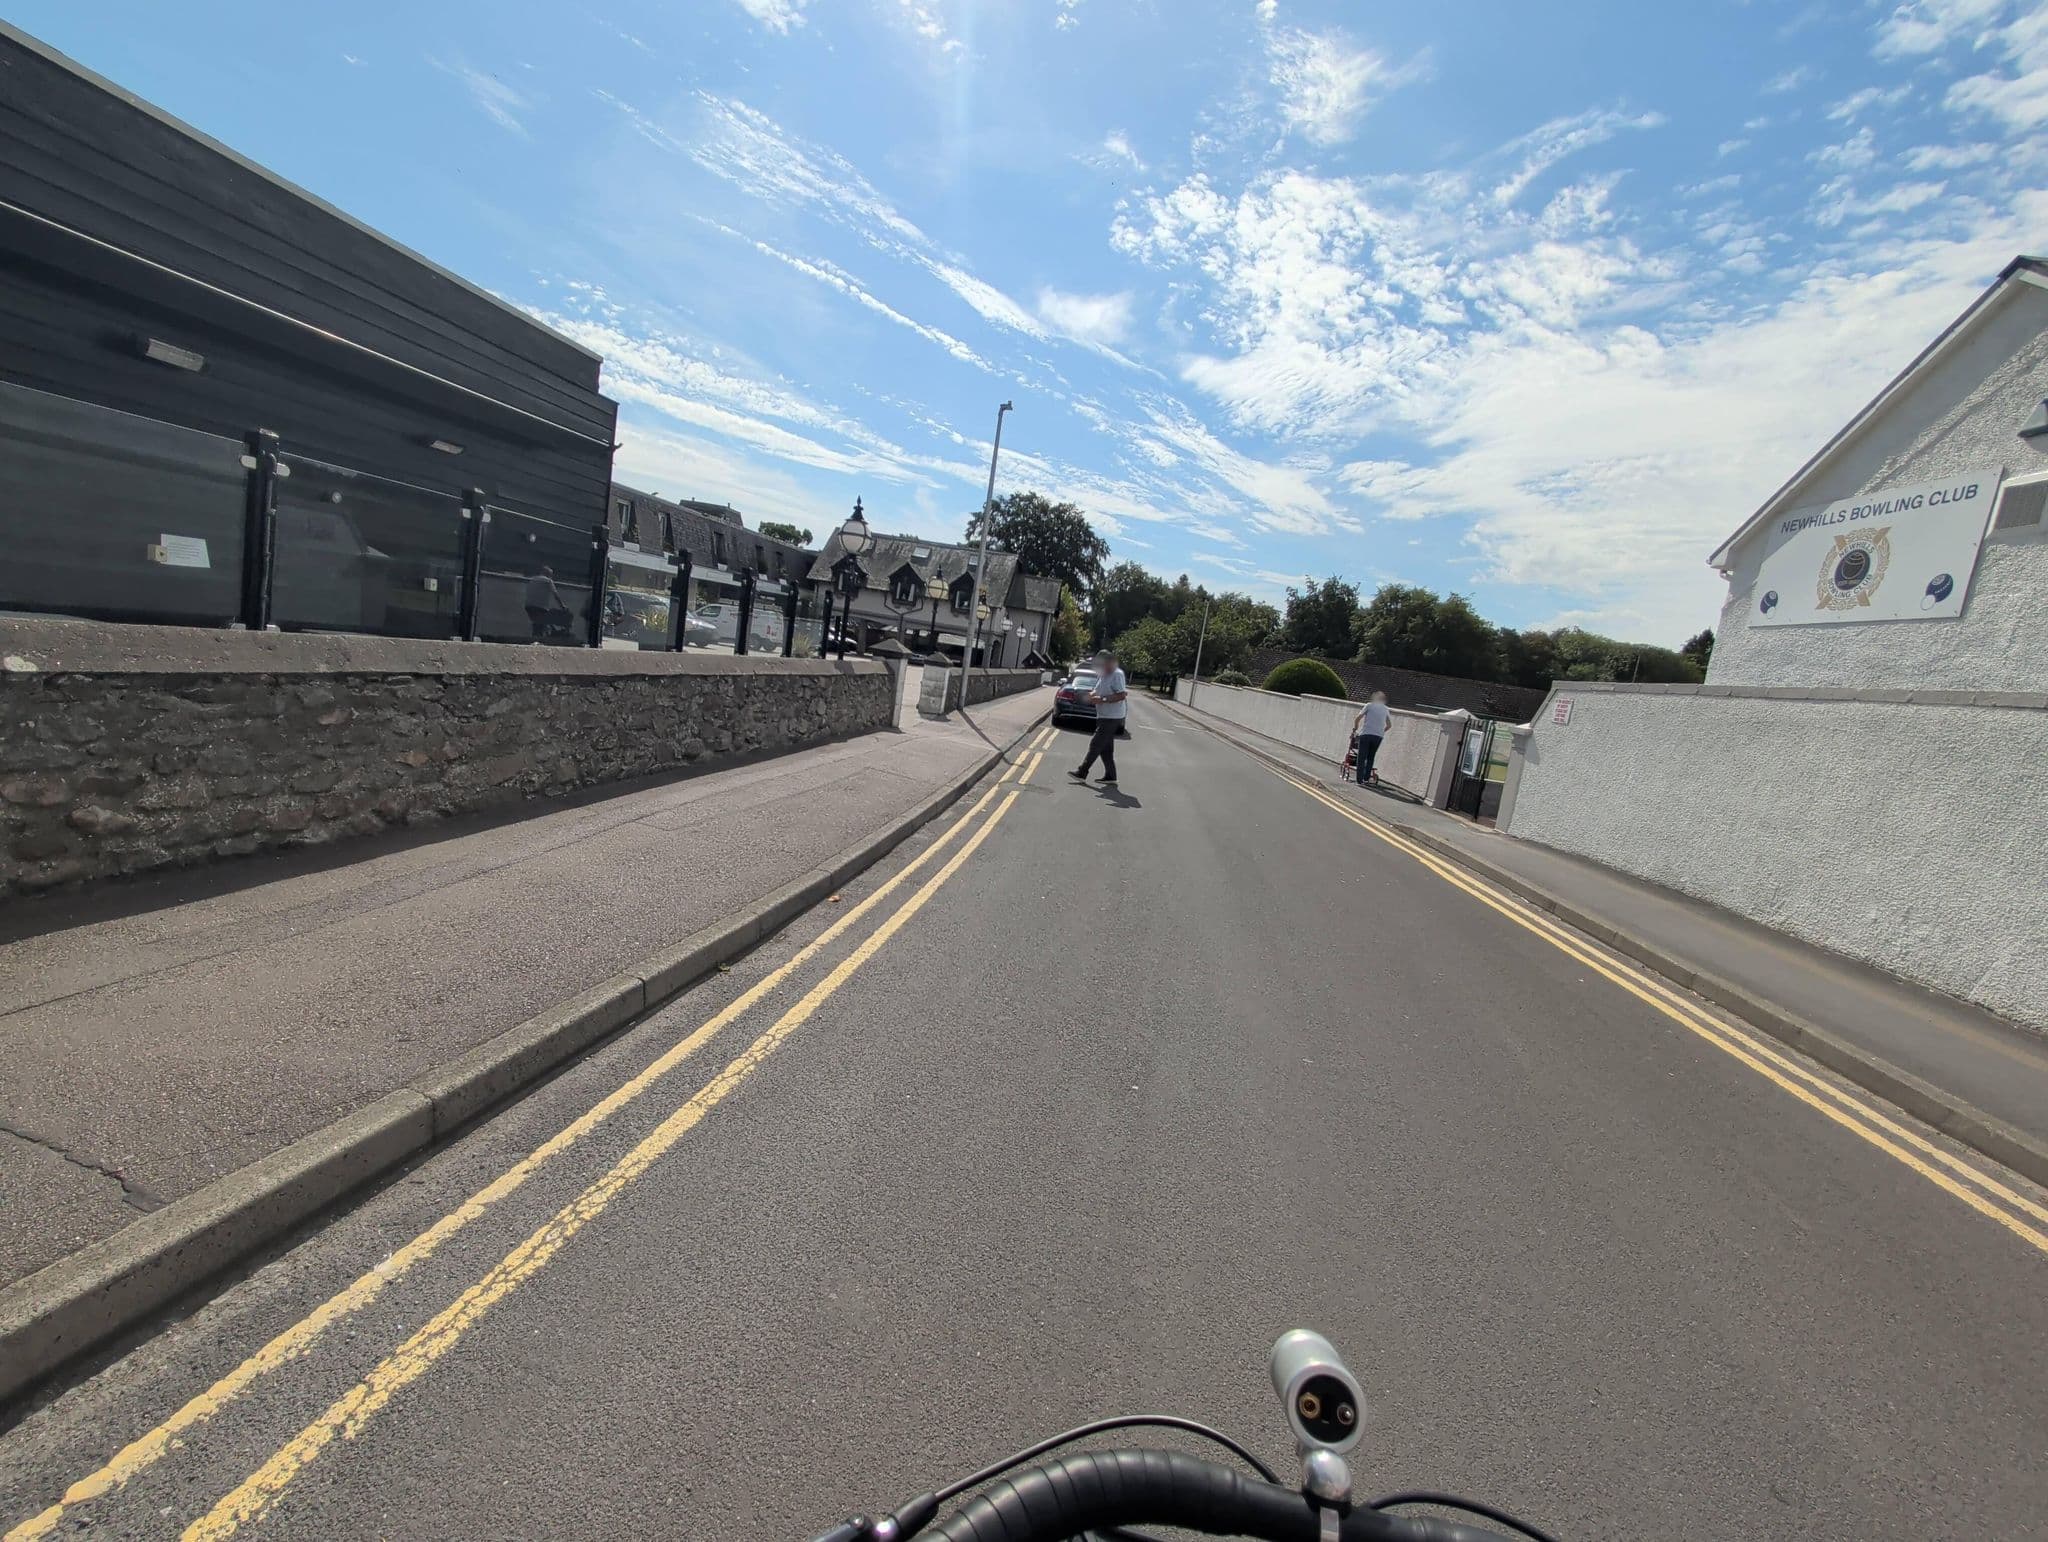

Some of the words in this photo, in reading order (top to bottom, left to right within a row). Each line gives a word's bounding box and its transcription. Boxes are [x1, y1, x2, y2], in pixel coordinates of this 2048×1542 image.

[1781, 510, 1846, 534] NEWHILLS
[1850, 495, 1923, 520] BOWLING
[1929, 484, 1979, 506] CLUB
[1839, 541, 1875, 558] NEWHILLS
[1827, 577, 1852, 598] BOWLING
